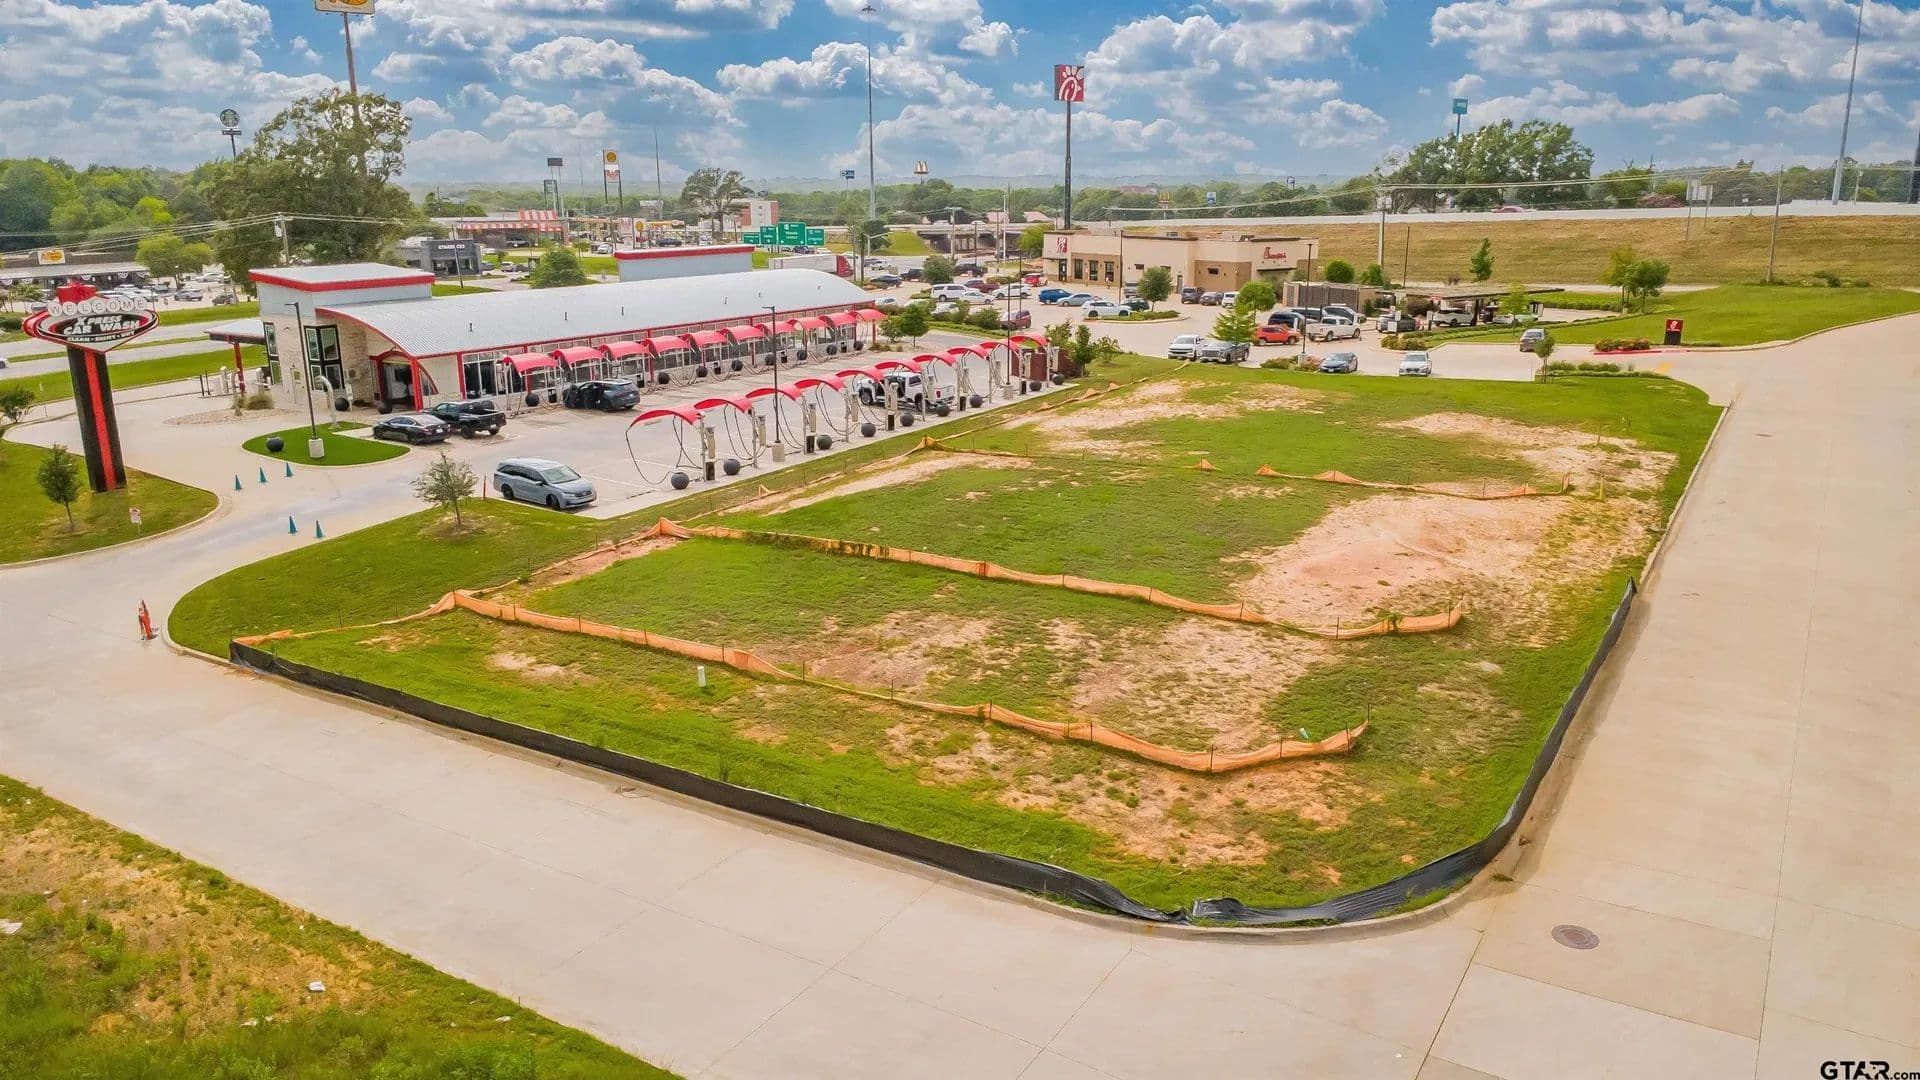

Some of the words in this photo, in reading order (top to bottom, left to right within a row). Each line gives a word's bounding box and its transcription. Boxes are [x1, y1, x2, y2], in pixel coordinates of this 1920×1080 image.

[49, 298, 146, 316] WELCOME
[63, 325, 92, 335] CAR
[100, 320, 140, 332] WASH
[76, 315, 122, 326] XPRESS
